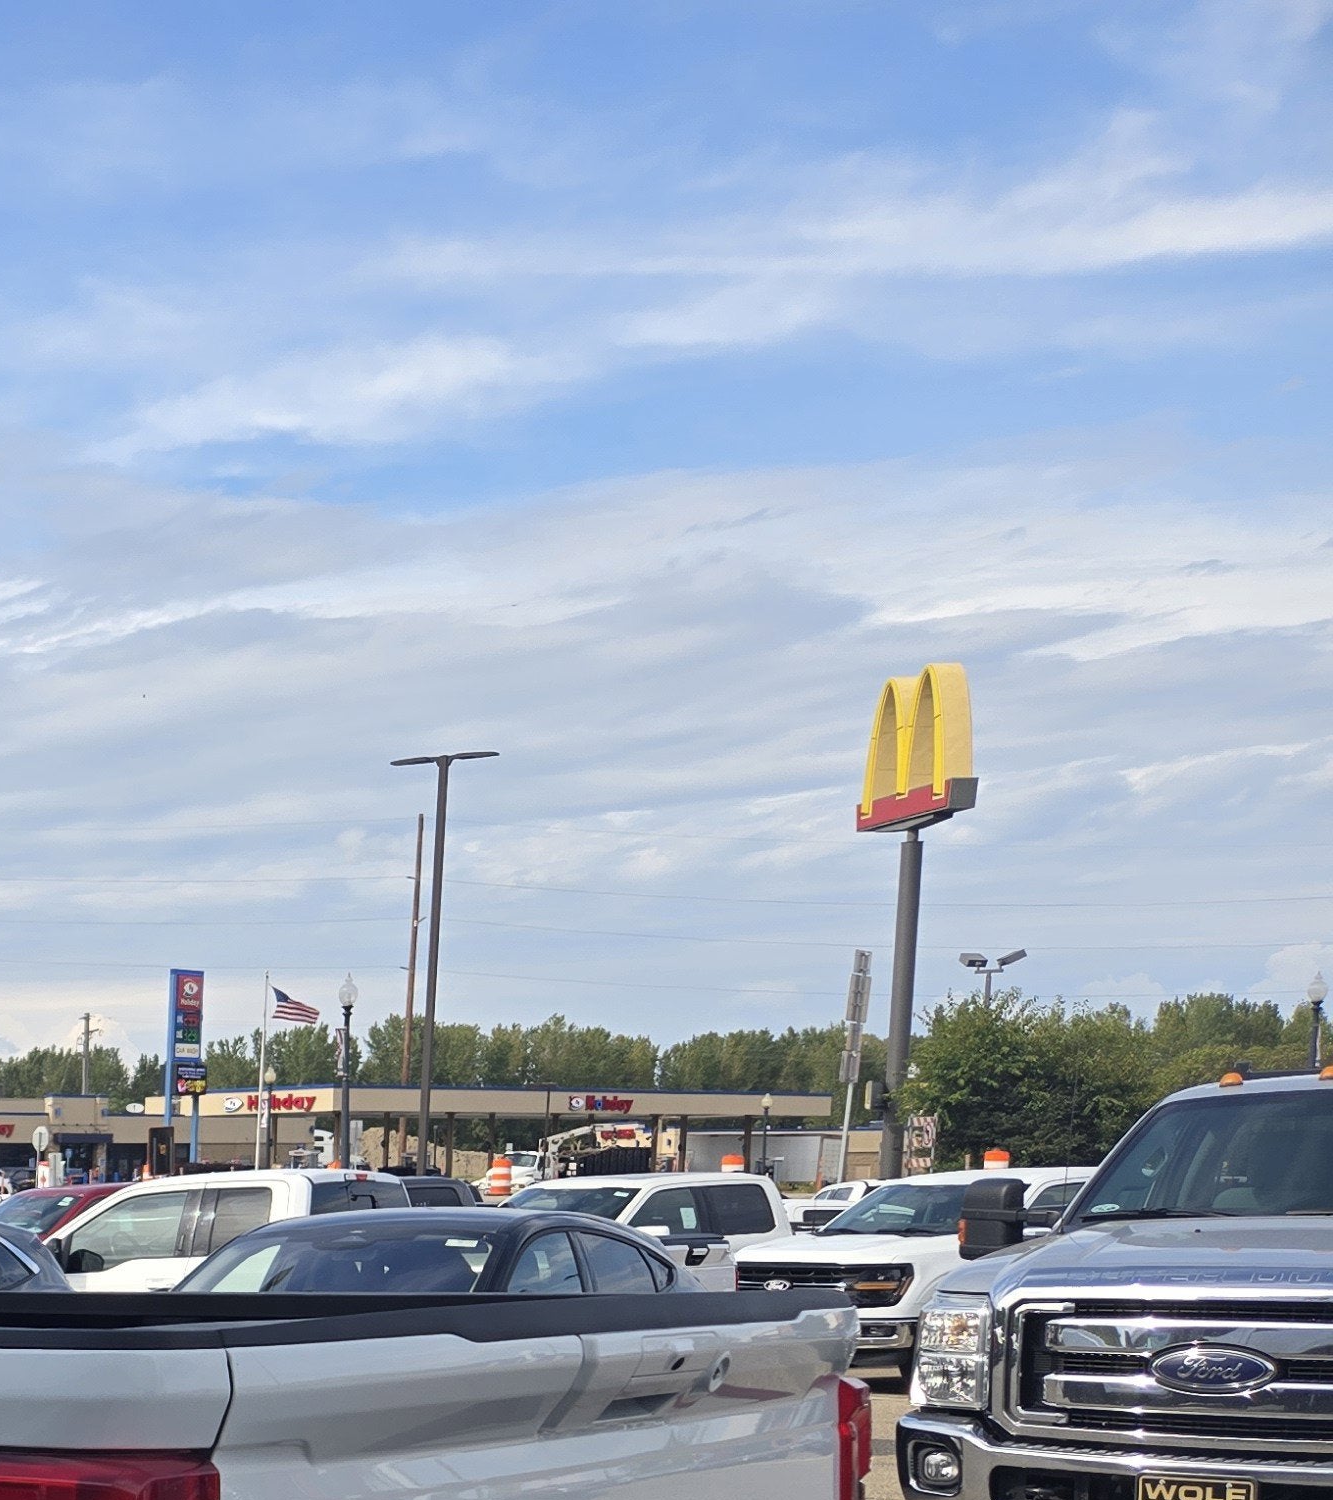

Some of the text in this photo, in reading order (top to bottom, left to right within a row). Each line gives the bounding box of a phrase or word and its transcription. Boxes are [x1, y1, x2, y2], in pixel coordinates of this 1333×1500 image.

[180, 999, 200, 1008] Holiday
[247, 1094, 317, 1113] Hliday
[1176, 1355, 1243, 1381] Ford
